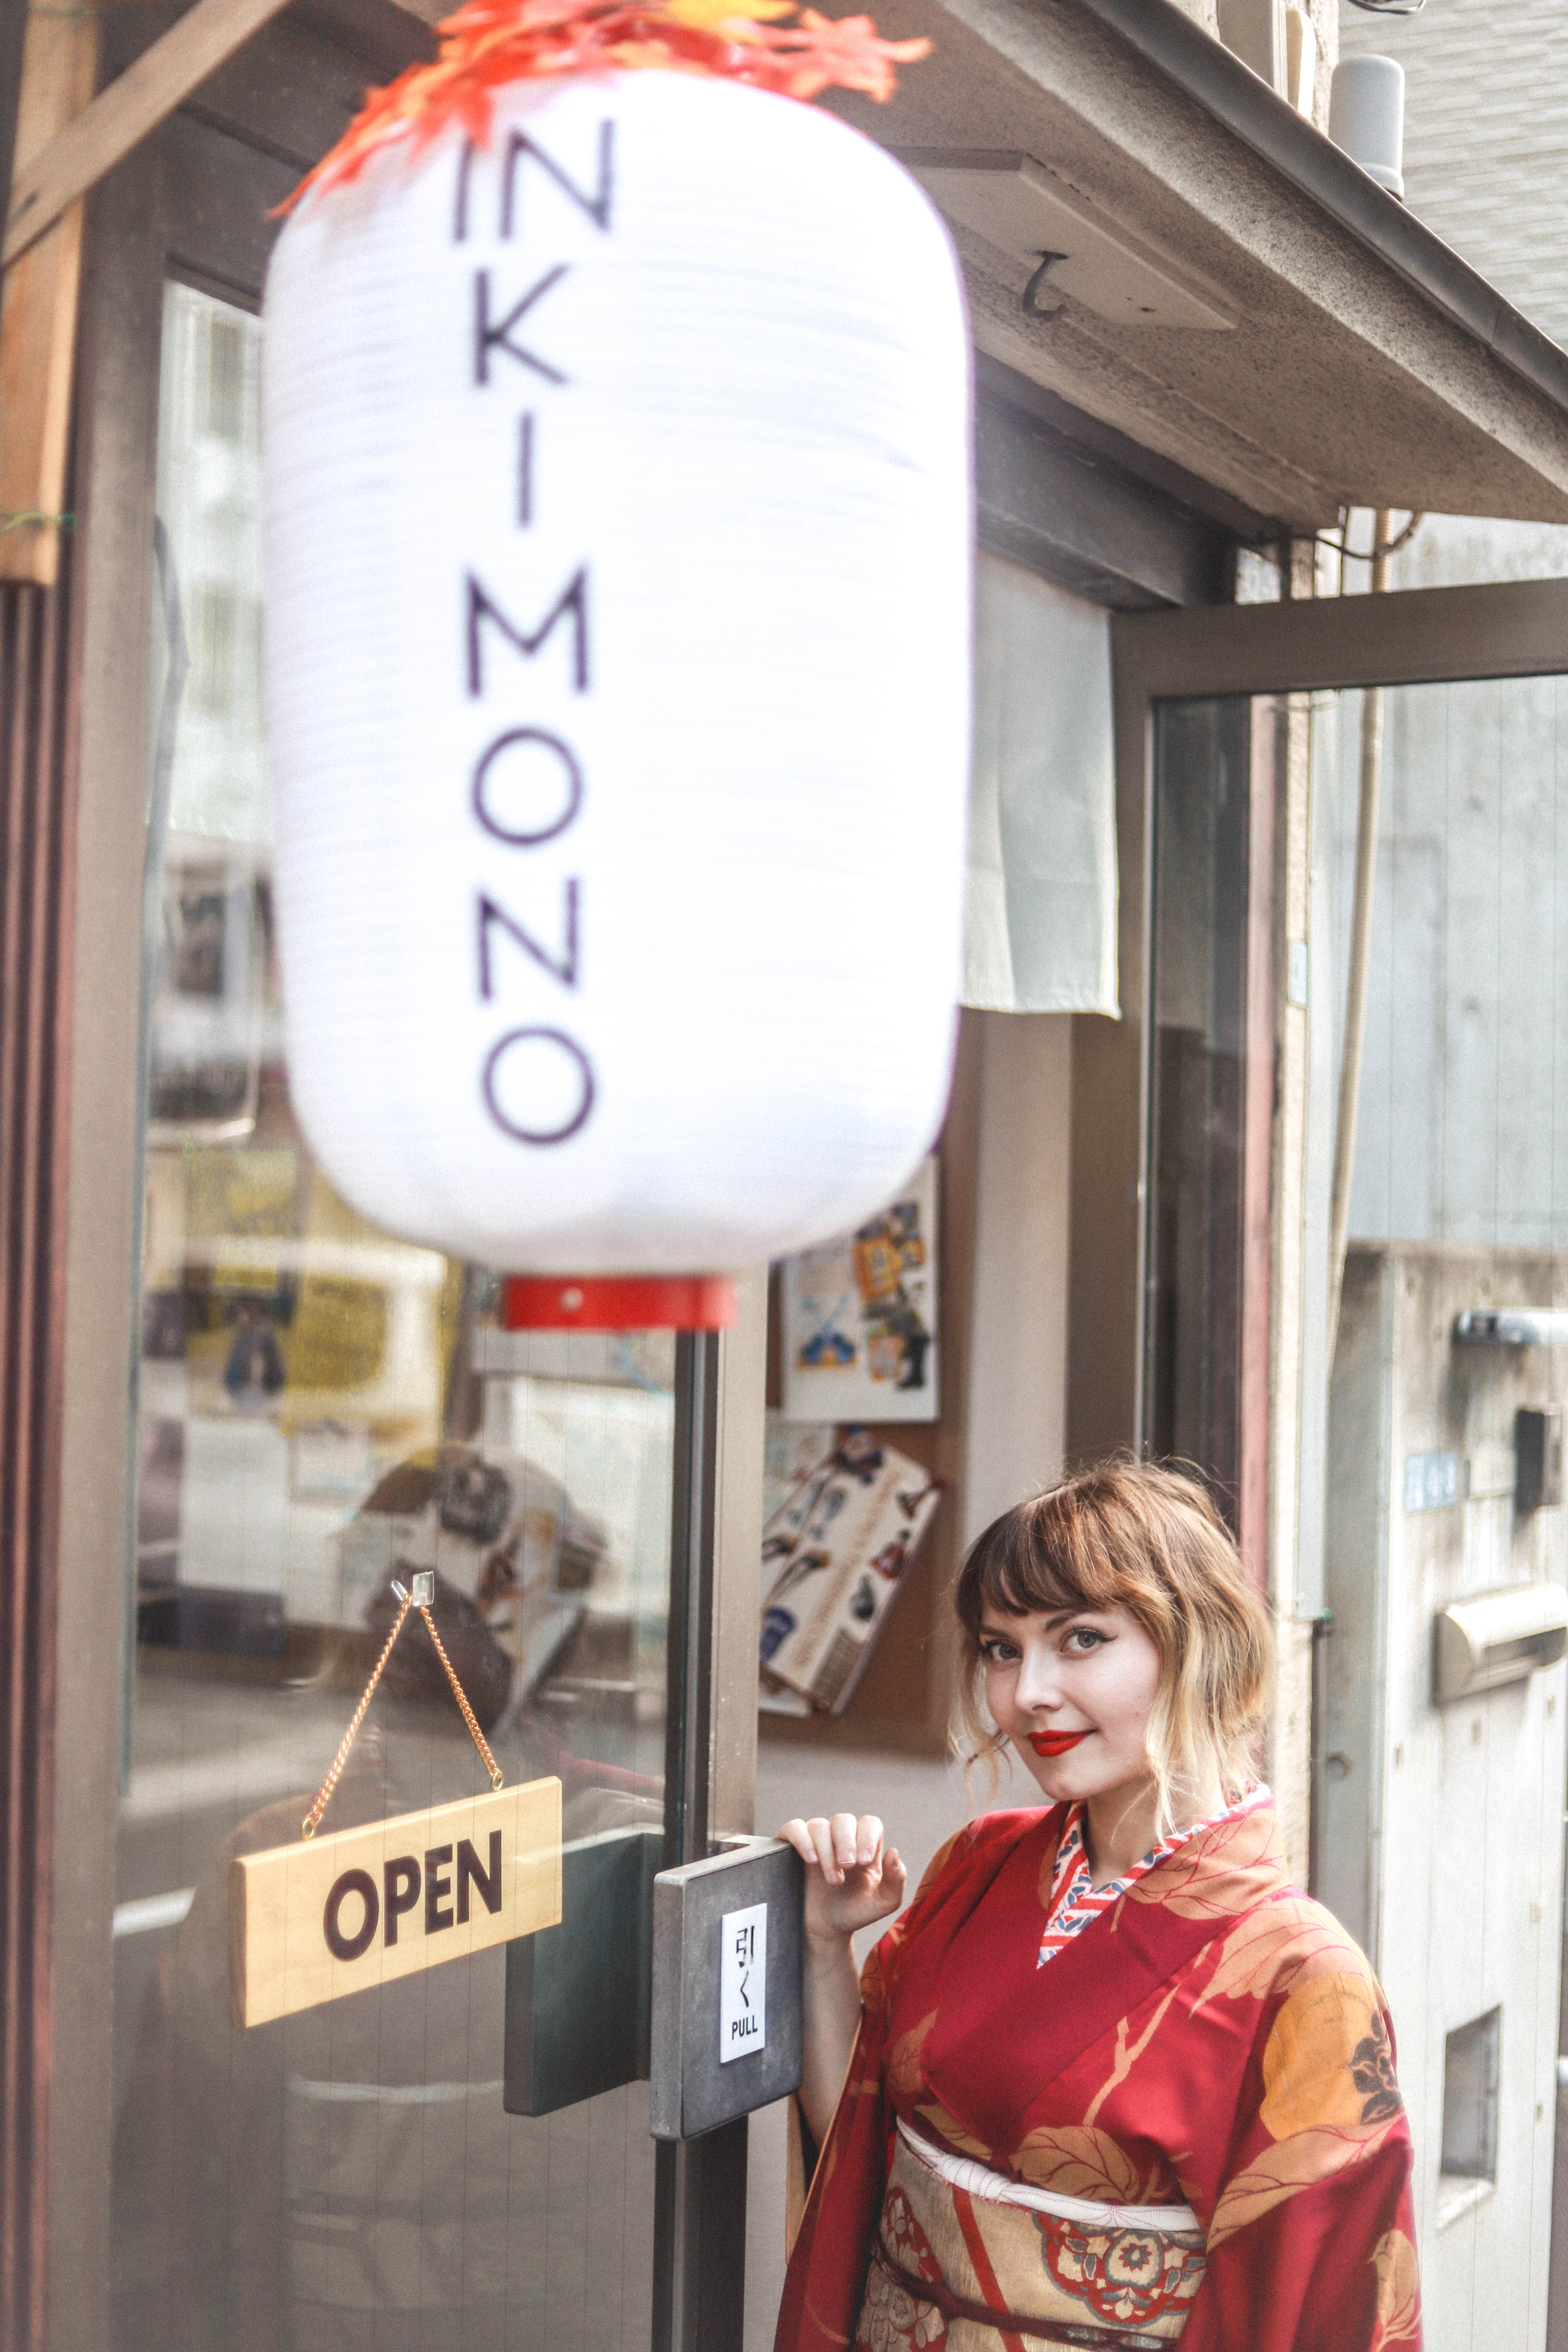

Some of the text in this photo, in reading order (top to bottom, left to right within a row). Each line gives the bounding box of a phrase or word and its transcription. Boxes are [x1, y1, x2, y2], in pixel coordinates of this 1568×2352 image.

[465, 262, 596, 1148] KIMONO
[323, 1829, 502, 1962] OPEN
[736, 1925, 755, 2008] 引く
[732, 2015, 758, 2041] PULL
